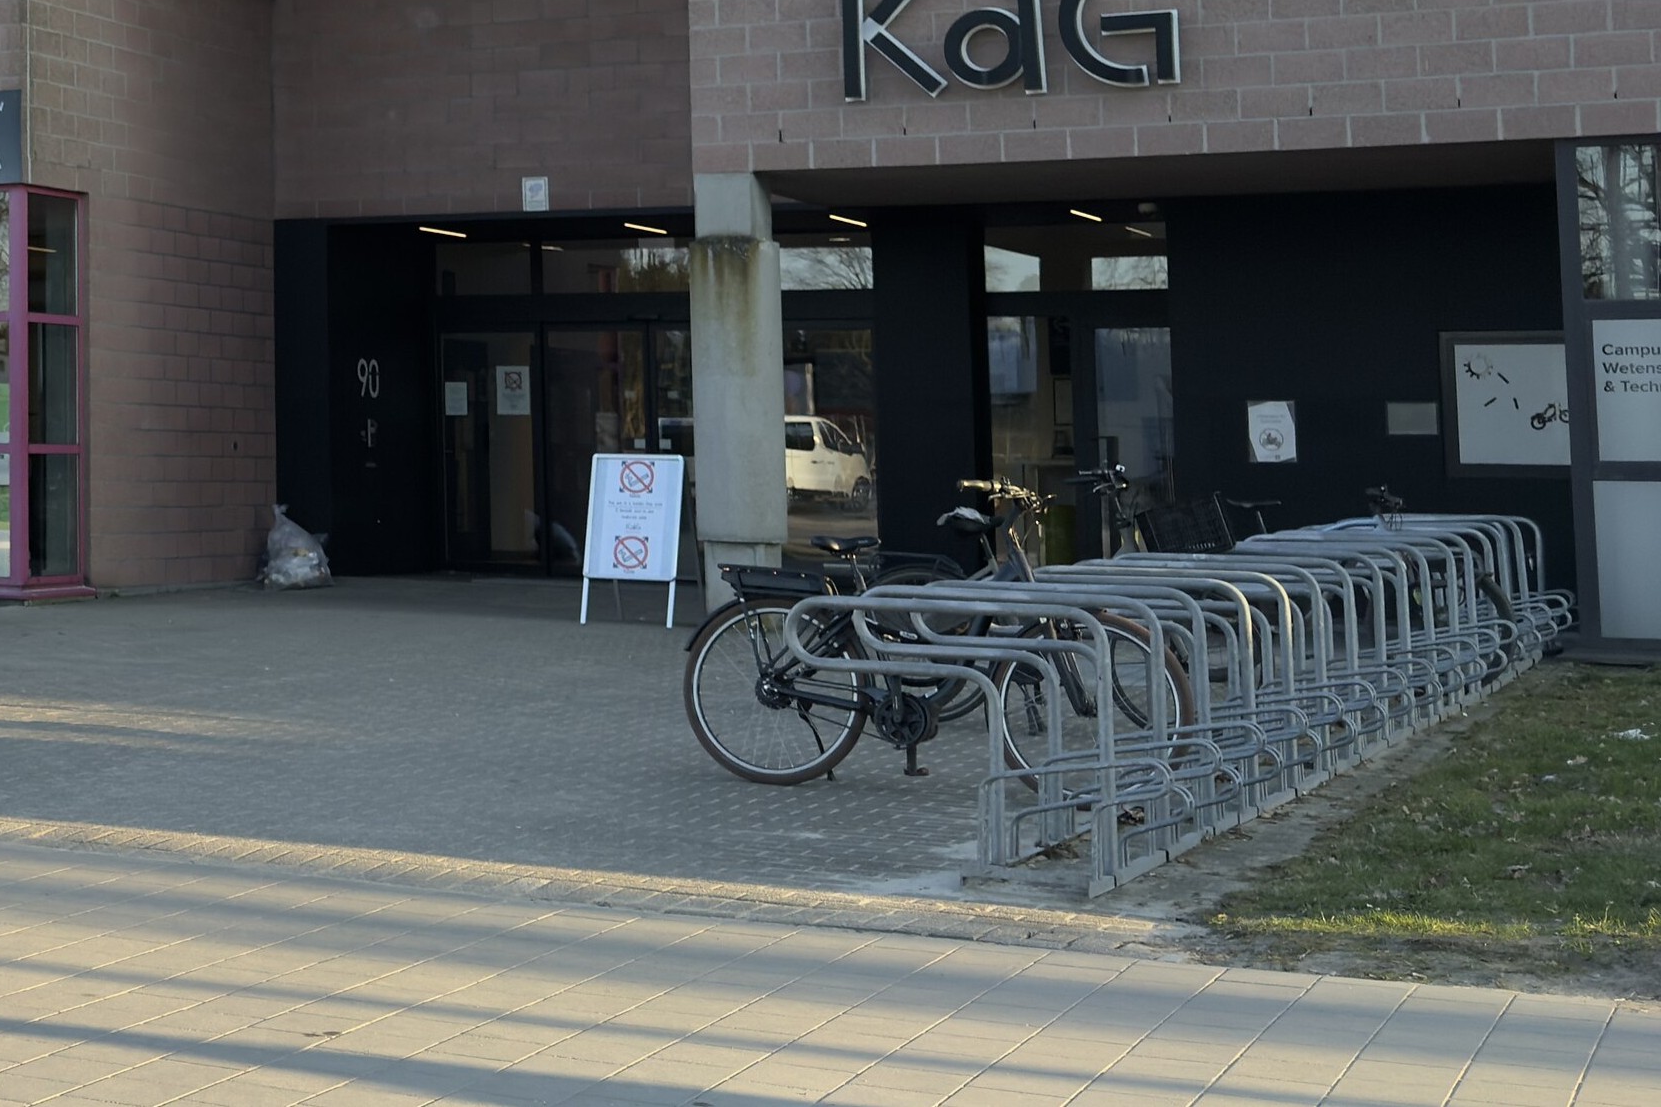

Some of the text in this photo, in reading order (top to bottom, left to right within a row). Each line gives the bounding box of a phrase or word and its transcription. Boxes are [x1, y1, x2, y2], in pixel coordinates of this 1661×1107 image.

[1602, 343, 1661, 358] Campu
[357, 358, 380, 399] 90
[1603, 380, 1661, 393] & Tech
